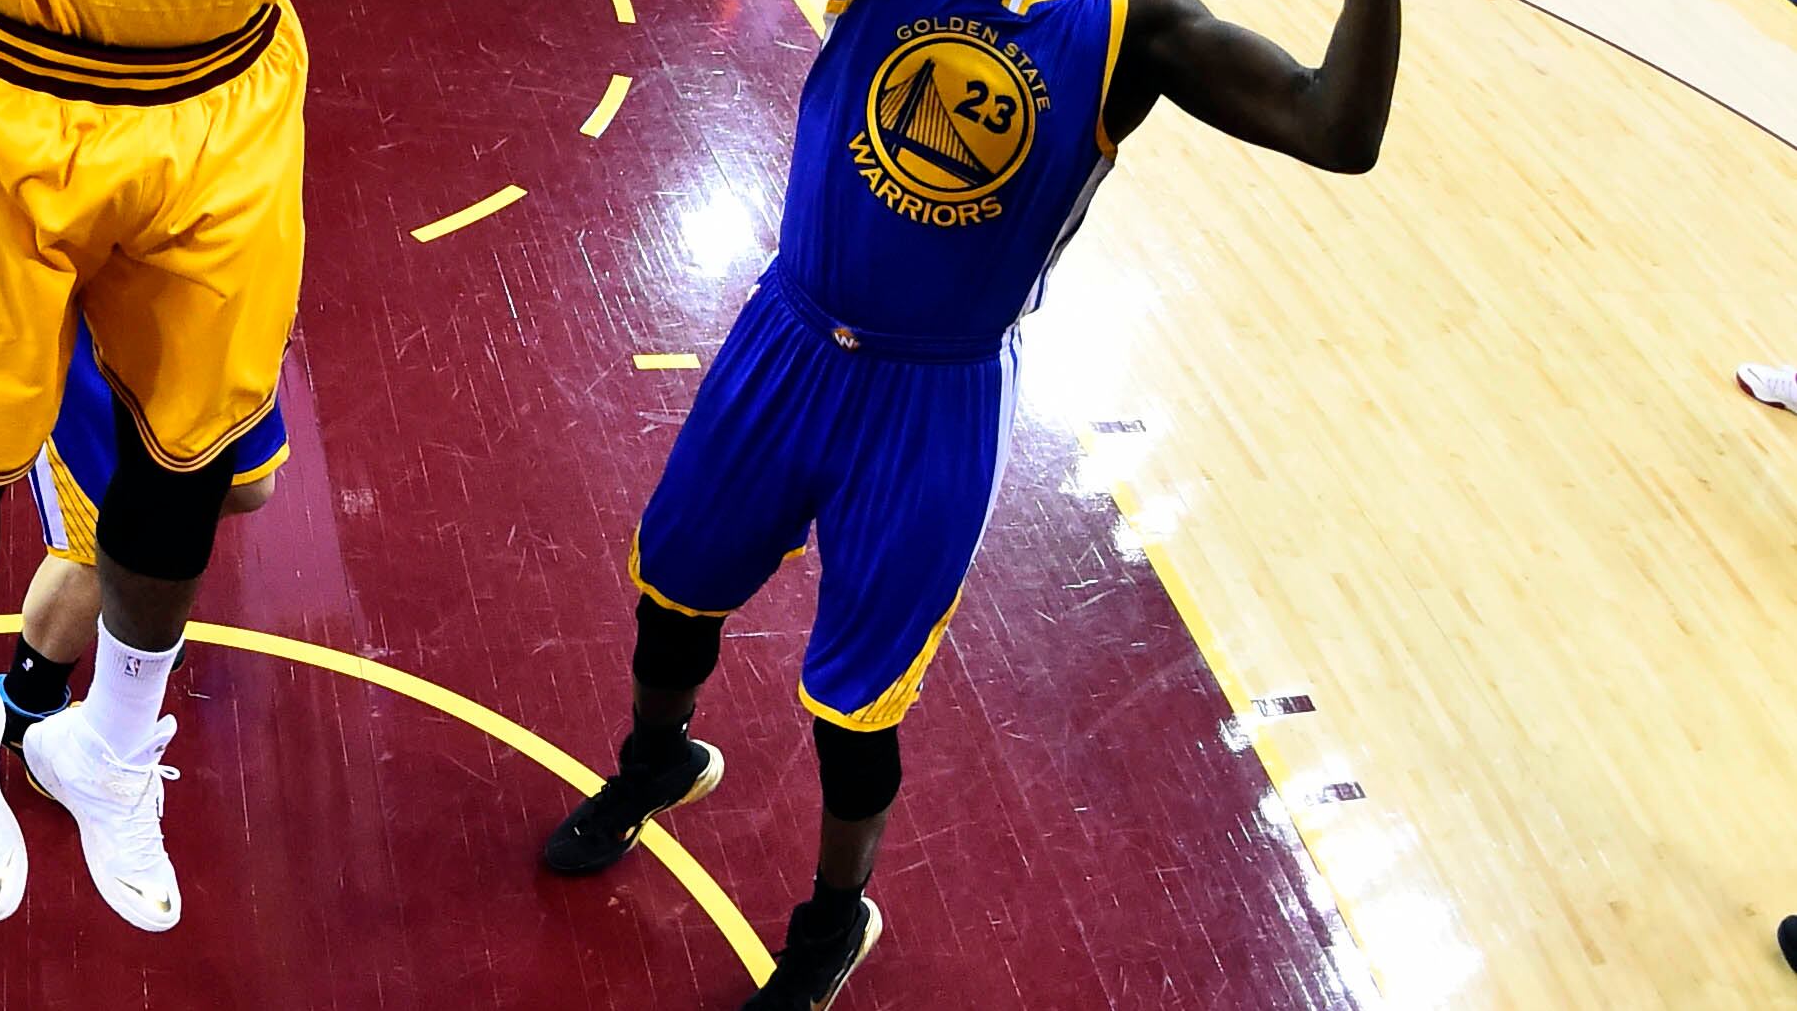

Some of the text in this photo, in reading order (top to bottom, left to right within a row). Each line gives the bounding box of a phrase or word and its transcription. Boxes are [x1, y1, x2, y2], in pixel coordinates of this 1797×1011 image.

[896, 16, 1052, 114] GOLDEN STATE
[953, 79, 1017, 135] 23
[847, 129, 1003, 228] WARRIORS
